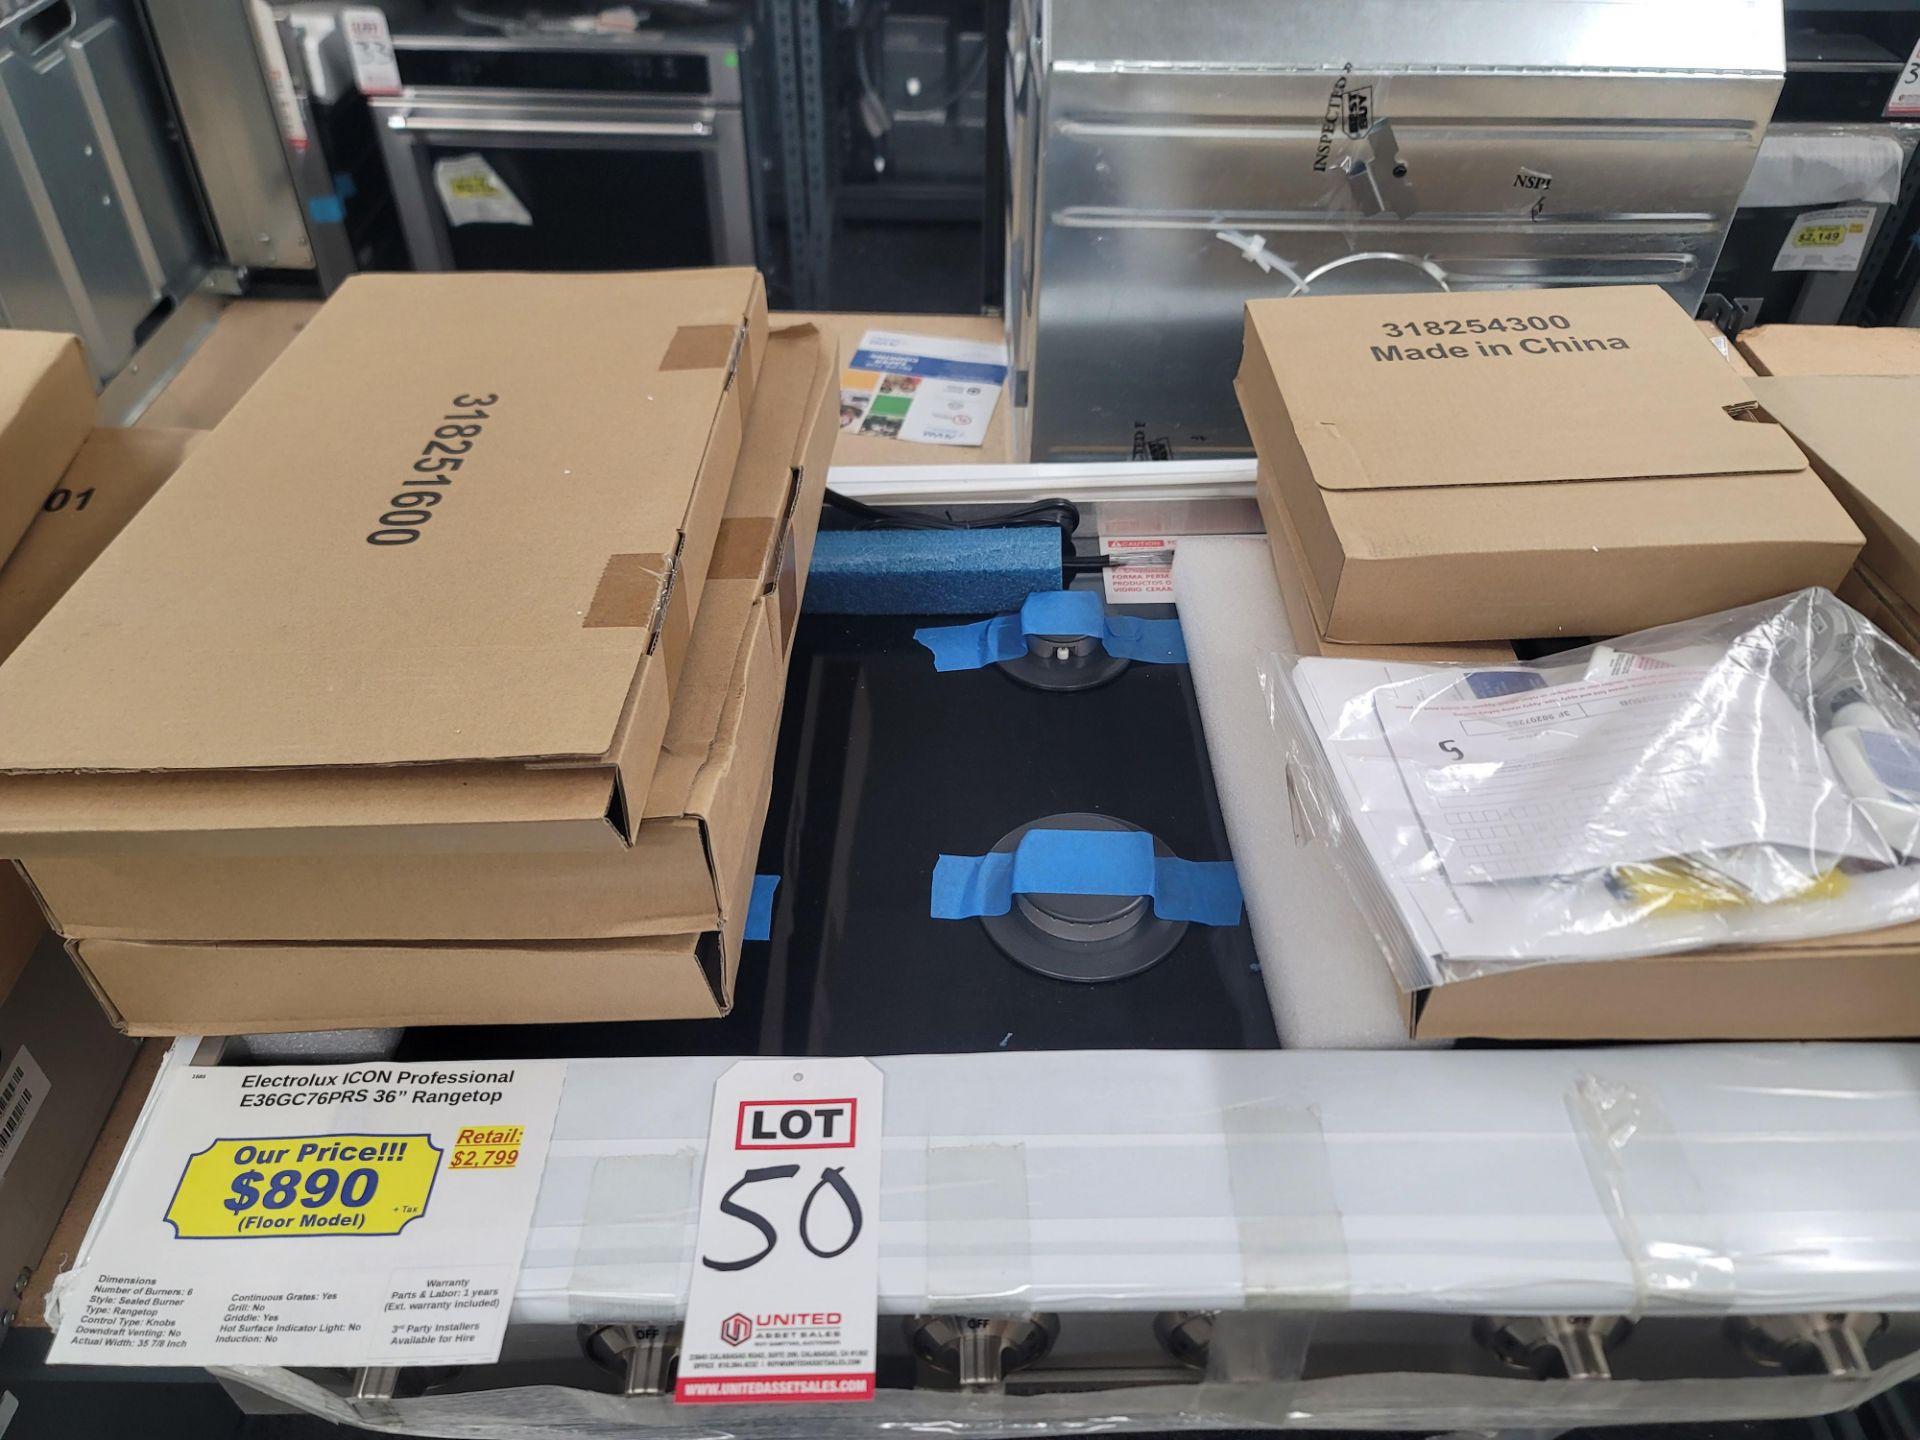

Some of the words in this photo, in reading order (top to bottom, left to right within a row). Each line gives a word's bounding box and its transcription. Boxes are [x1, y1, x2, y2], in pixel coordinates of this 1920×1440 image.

[1313, 77, 1347, 172] INSPECTED
[1381, 314, 1571, 338] 318254300
[1370, 342, 1470, 362] Made
[1474, 340, 1513, 357] in
[1519, 337, 1631, 355] China
[366, 393, 499, 546] 318251600
[44, 487, 97, 512] 01
[241, 1072, 337, 1088] Electrolux
[342, 1070, 392, 1085] ICON
[397, 1069, 515, 1085] Professional
[239, 1089, 368, 1108] E36GC76PRS
[412, 1089, 502, 1106] Rangetop
[752, 1109, 844, 1139] LOT
[456, 1129, 524, 1145] Retail:
[233, 1145, 289, 1165] Our
[296, 1142, 408, 1163] Price!!!
[451, 1149, 519, 1167] $2,799
[223, 1167, 379, 1216] $890
[402, 1205, 419, 1214] Tax
[237, 1215, 295, 1233] (Floor
[299, 1213, 366, 1230] Model)
[703, 1164, 863, 1271] 50
[98, 1275, 157, 1285] Dimensions
[427, 1279, 471, 1288] Warranty
[94, 1286, 131, 1295] Number
[133, 1286, 143, 1295] of
[145, 1288, 186, 1296] Burners:
[187, 1288, 194, 1296] 6
[231, 1293, 283, 1302] Continuous
[286, 1293, 320, 1301] Grates:
[322, 1292, 338, 1300] Yes
[391, 1291, 417, 1299] Parts
[419, 1290, 426, 1298] &
[429, 1289, 462, 1298] Labor:
[463, 1289, 469, 1297] 1
[471, 1289, 499, 1298] years
[89, 1295, 116, 1305] Style:
[118, 1296, 150, 1306] Sealed
[152, 1298, 184, 1306] Burner
[384, 1302, 406, 1312] (Ext.
[409, 1301, 452, 1311] warranty
[454, 1298, 500, 1309] included)
[86, 1305, 111, 1315] Type:
[113, 1307, 158, 1317] Rangetop
[227, 1304, 250, 1312] Grill:
[80, 1316, 116, 1325] Control
[119, 1318, 144, 1327] Type:
[145, 1318, 176, 1327] Knobs
[223, 1314, 261, 1322] Griddle:
[756, 1313, 842, 1326] UNITED
[968, 1318, 990, 1328] OFF
[75, 1325, 126, 1336] Downdraft
[128, 1328, 166, 1338] Venting:
[168, 1329, 182, 1337] No
[220, 1324, 236, 1332] Hot
[238, 1324, 273, 1332] Surface
[276, 1324, 317, 1332] Indicator
[319, 1324, 346, 1334] Light:
[348, 1323, 361, 1331] No
[406, 1324, 432, 1334] Party
[435, 1322, 480, 1332] Installers
[636, 1329, 659, 1339] OFF
[215, 1335, 263, 1343] Induction:
[264, 1335, 278, 1343] No
[390, 1335, 436, 1345] Available
[439, 1334, 453, 1343] for
[455, 1334, 476, 1342] Hire
[756, 1331, 797, 1339] ASSET
[800, 1330, 841, 1338] SALES
[71, 1336, 102, 1346] Actual
[105, 1338, 136, 1347] Width:
[137, 1339, 149, 1347] 35
[151, 1339, 165, 1347] 7/8
[167, 1339, 188, 1348] Inch
[685, 1379, 867, 1396] WWW.UNITEDASSETSALES.COM
